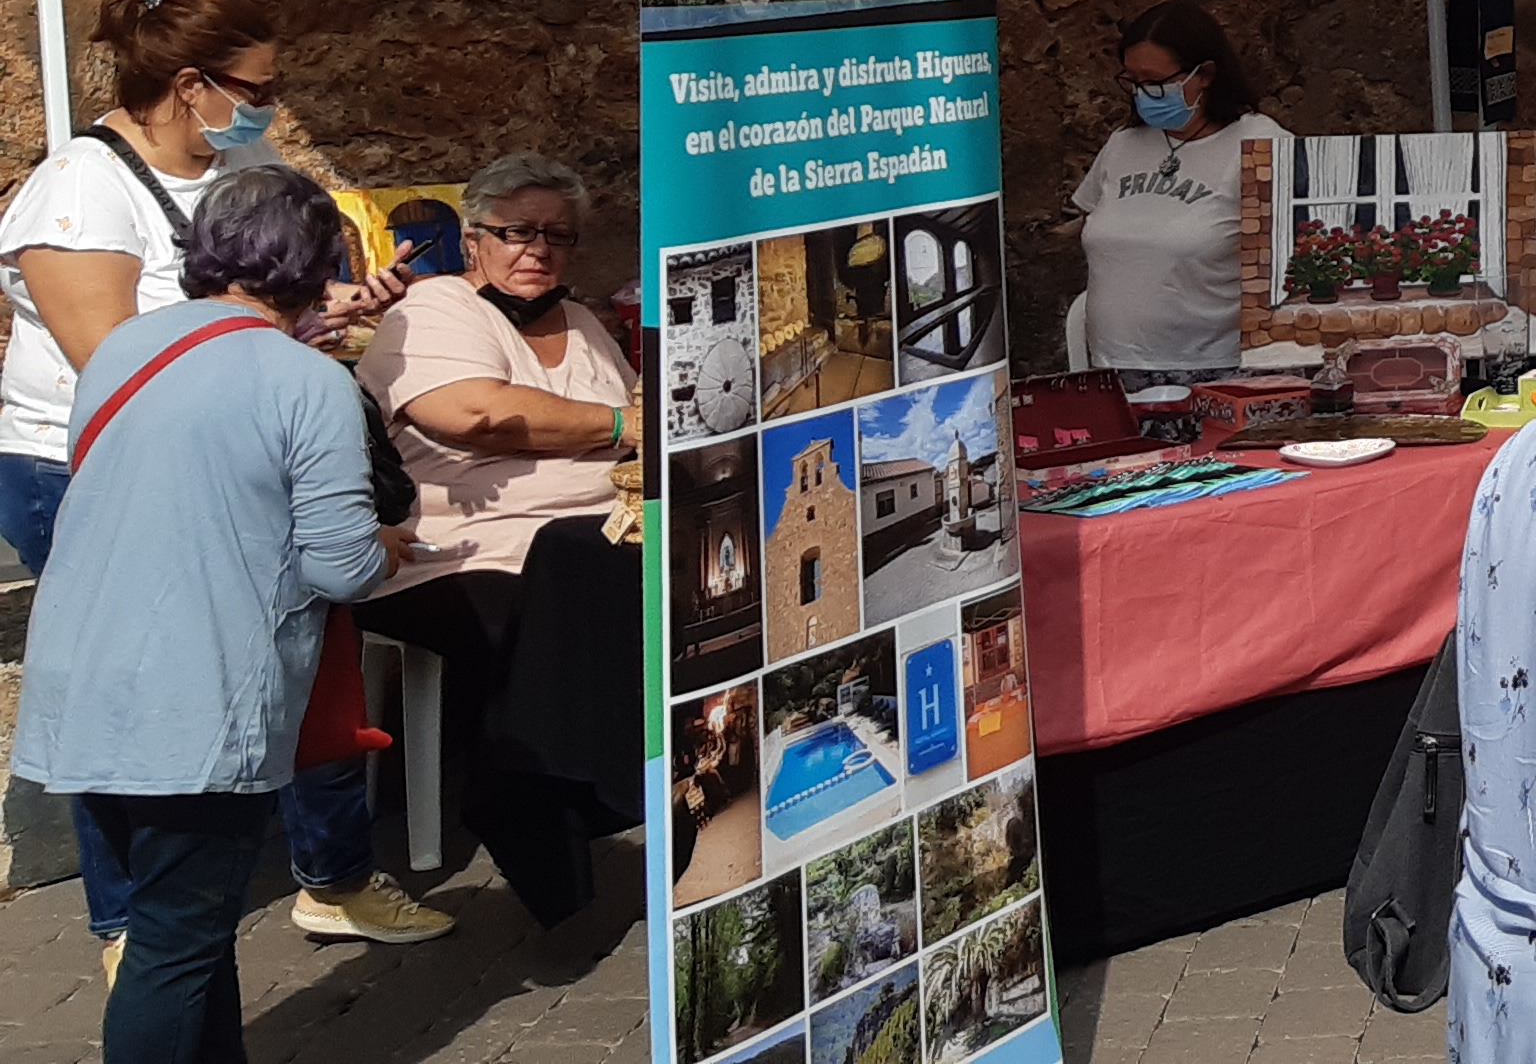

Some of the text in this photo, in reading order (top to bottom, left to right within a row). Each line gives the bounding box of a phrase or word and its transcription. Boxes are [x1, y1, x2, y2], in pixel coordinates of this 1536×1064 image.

[669, 50, 992, 105] Visita, admira y disfruta Higueras,
[685, 91, 989, 156] en el corazón del Parque Natural
[750, 144, 947, 198] de la Sierra Espadán
[1118, 172, 1213, 205] FRIDAY
[918, 683, 940, 731] H
